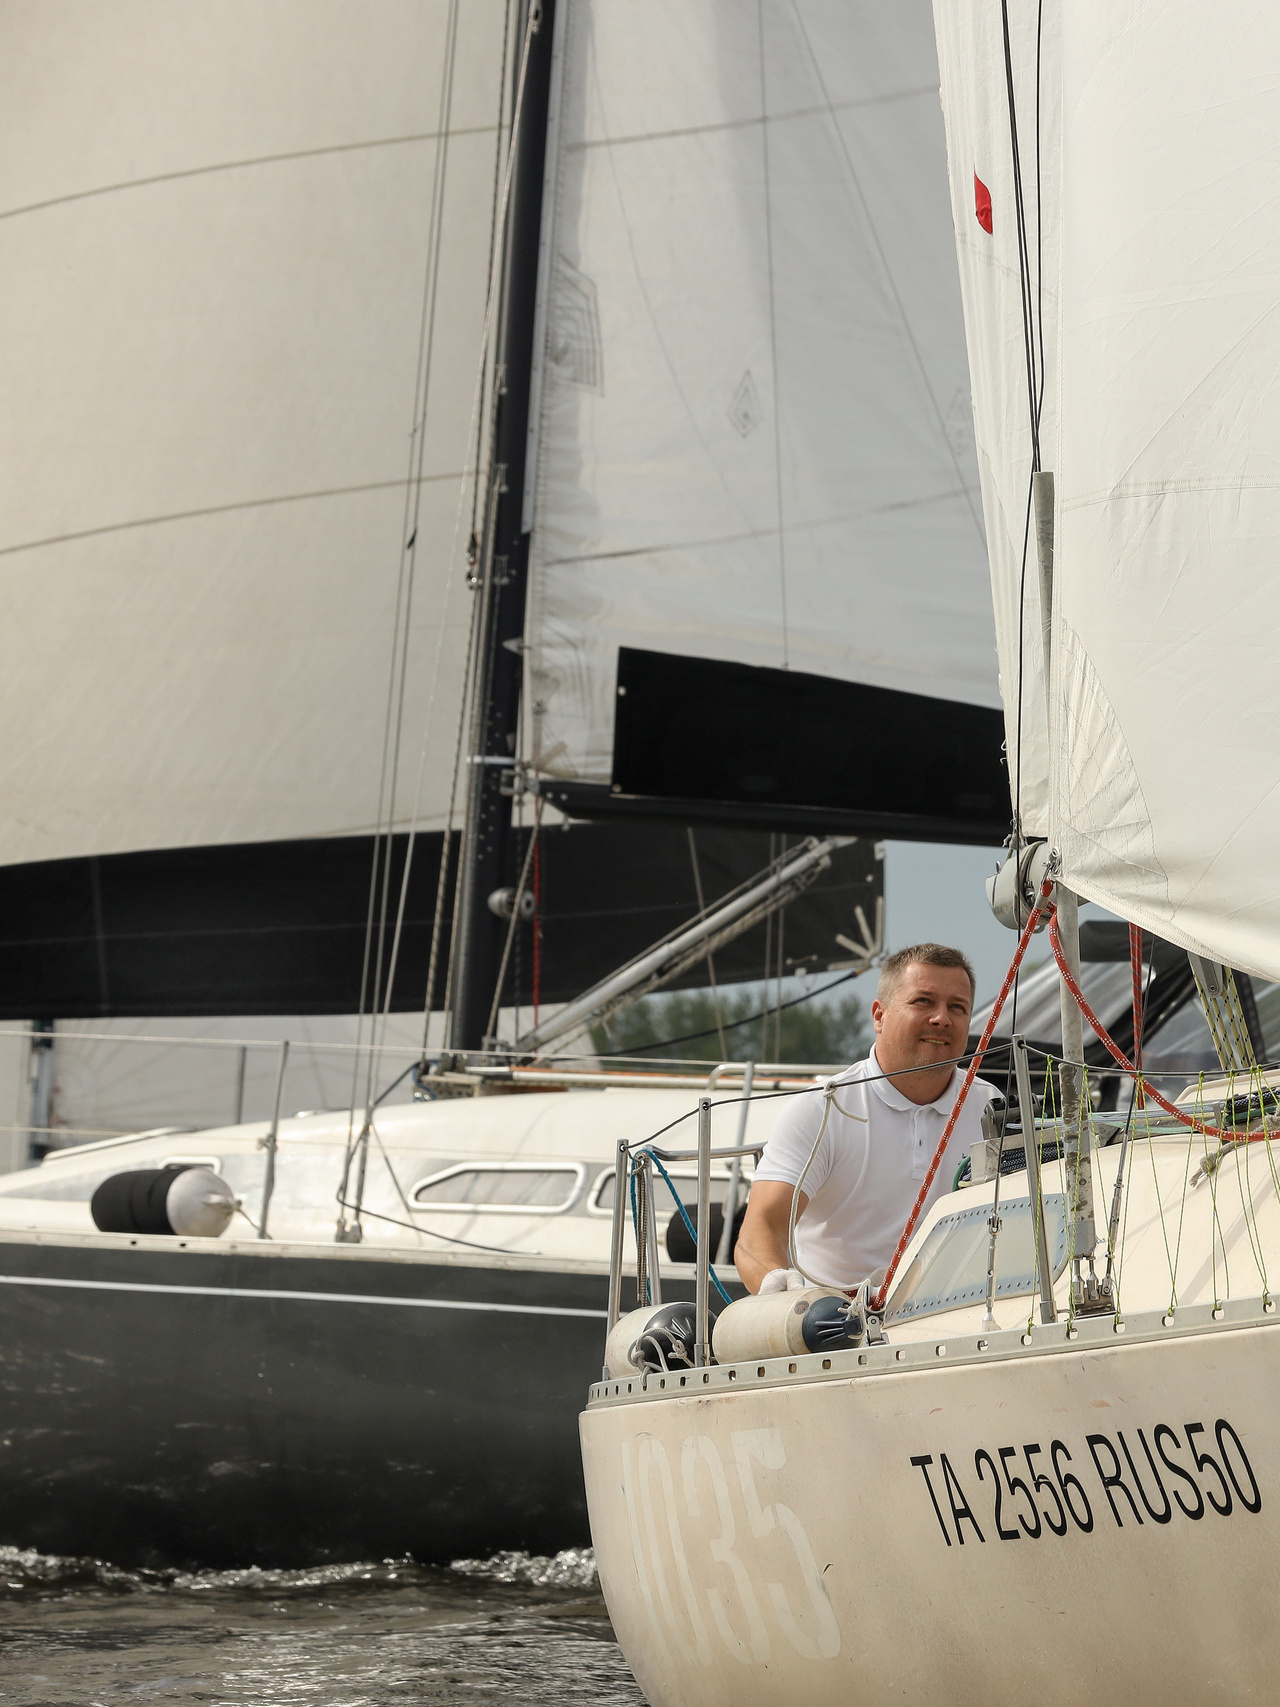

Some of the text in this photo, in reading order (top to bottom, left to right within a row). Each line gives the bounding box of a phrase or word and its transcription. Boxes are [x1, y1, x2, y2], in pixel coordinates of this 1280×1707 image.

[620, 1426, 841, 1668] 1035
[910, 1418, 1262, 1546] TA 2556 RUS50
